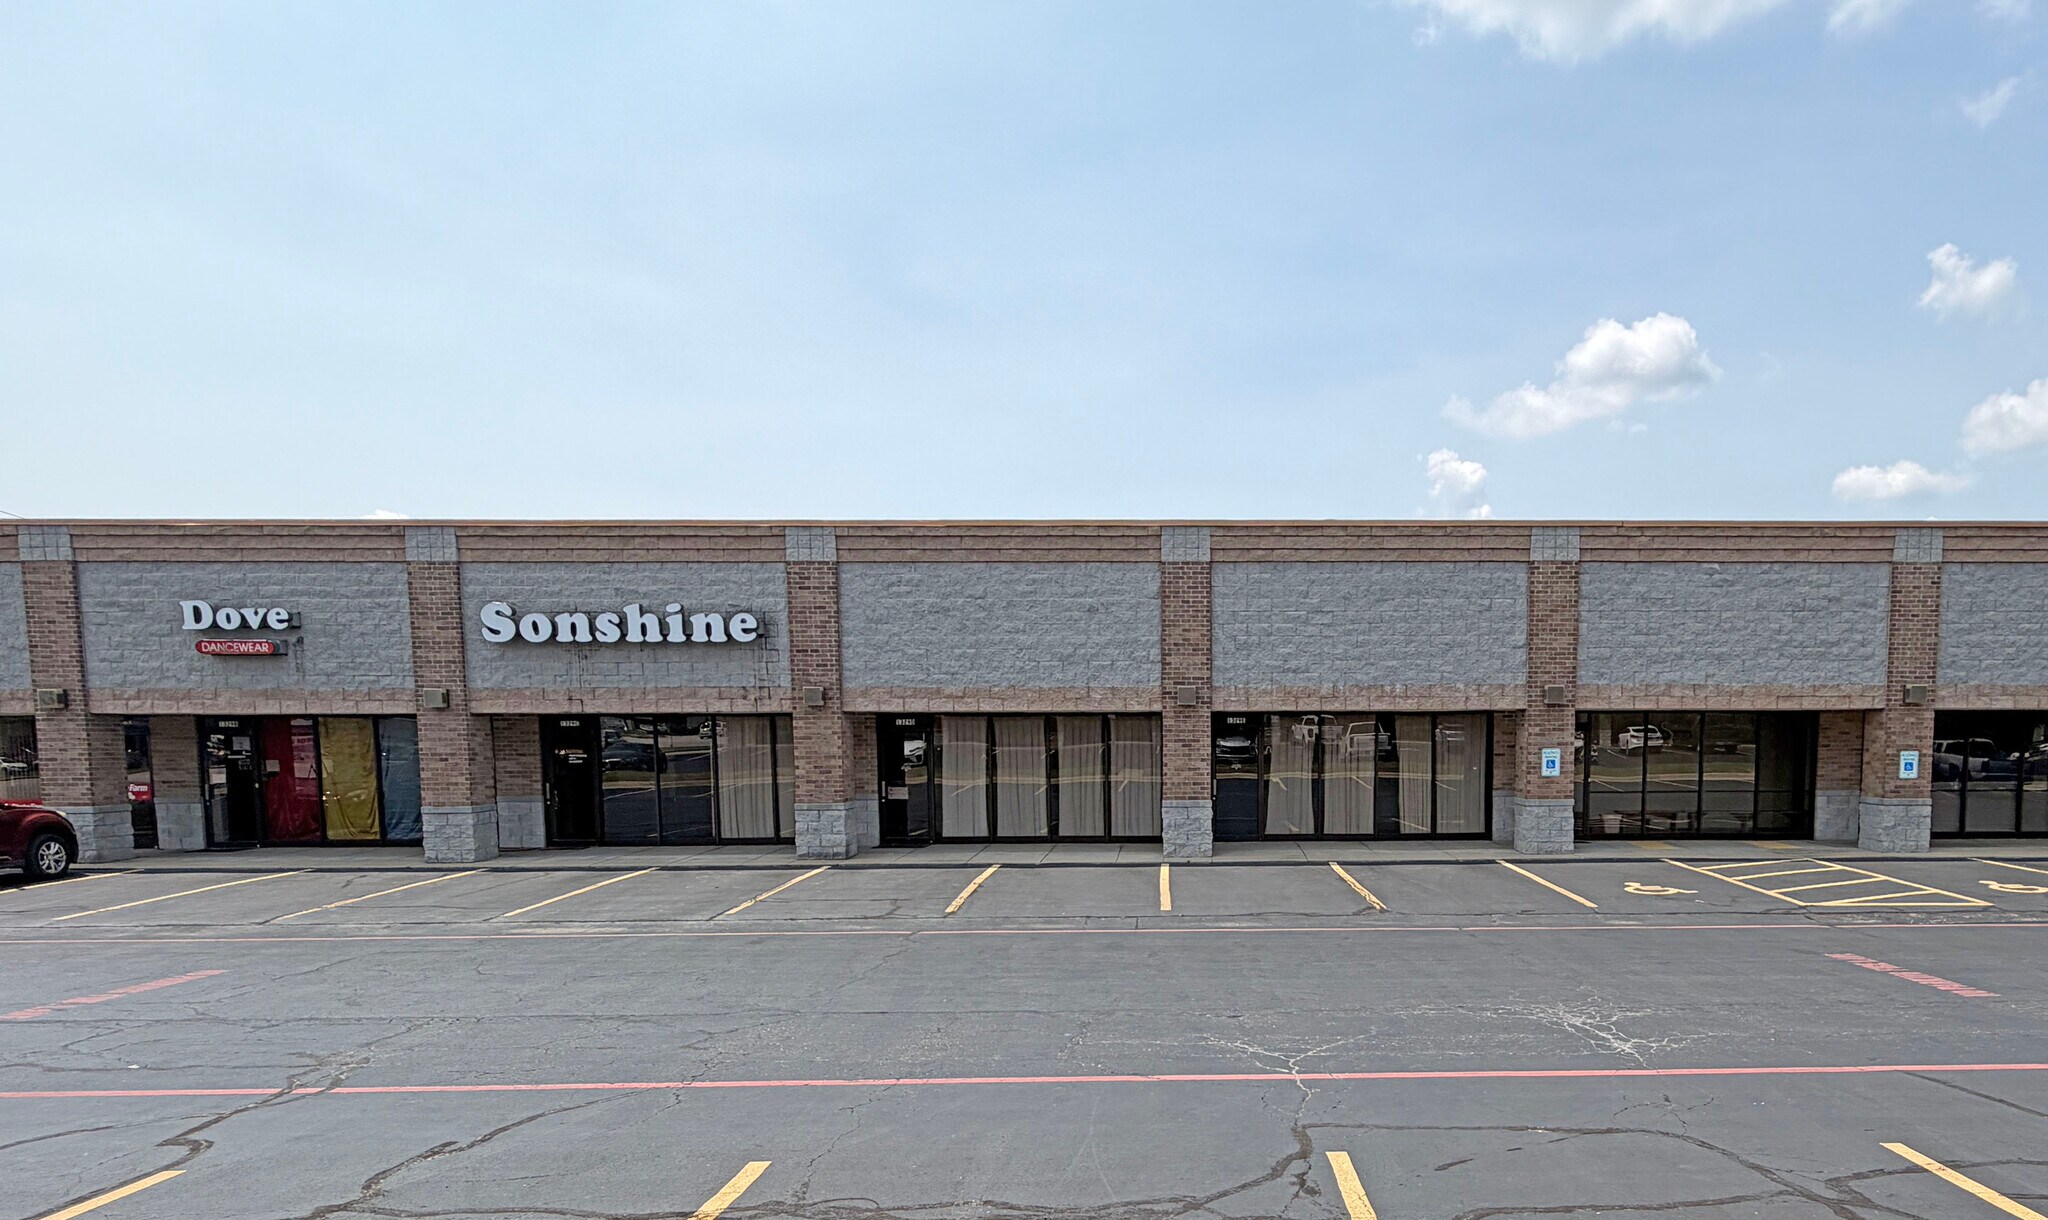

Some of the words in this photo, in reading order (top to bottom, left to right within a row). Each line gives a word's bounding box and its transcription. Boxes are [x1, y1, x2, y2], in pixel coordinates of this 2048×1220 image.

[179, 600, 289, 630] Dove
[480, 601, 758, 643] Sonshine
[201, 642, 269, 653] DANCEWEAR
